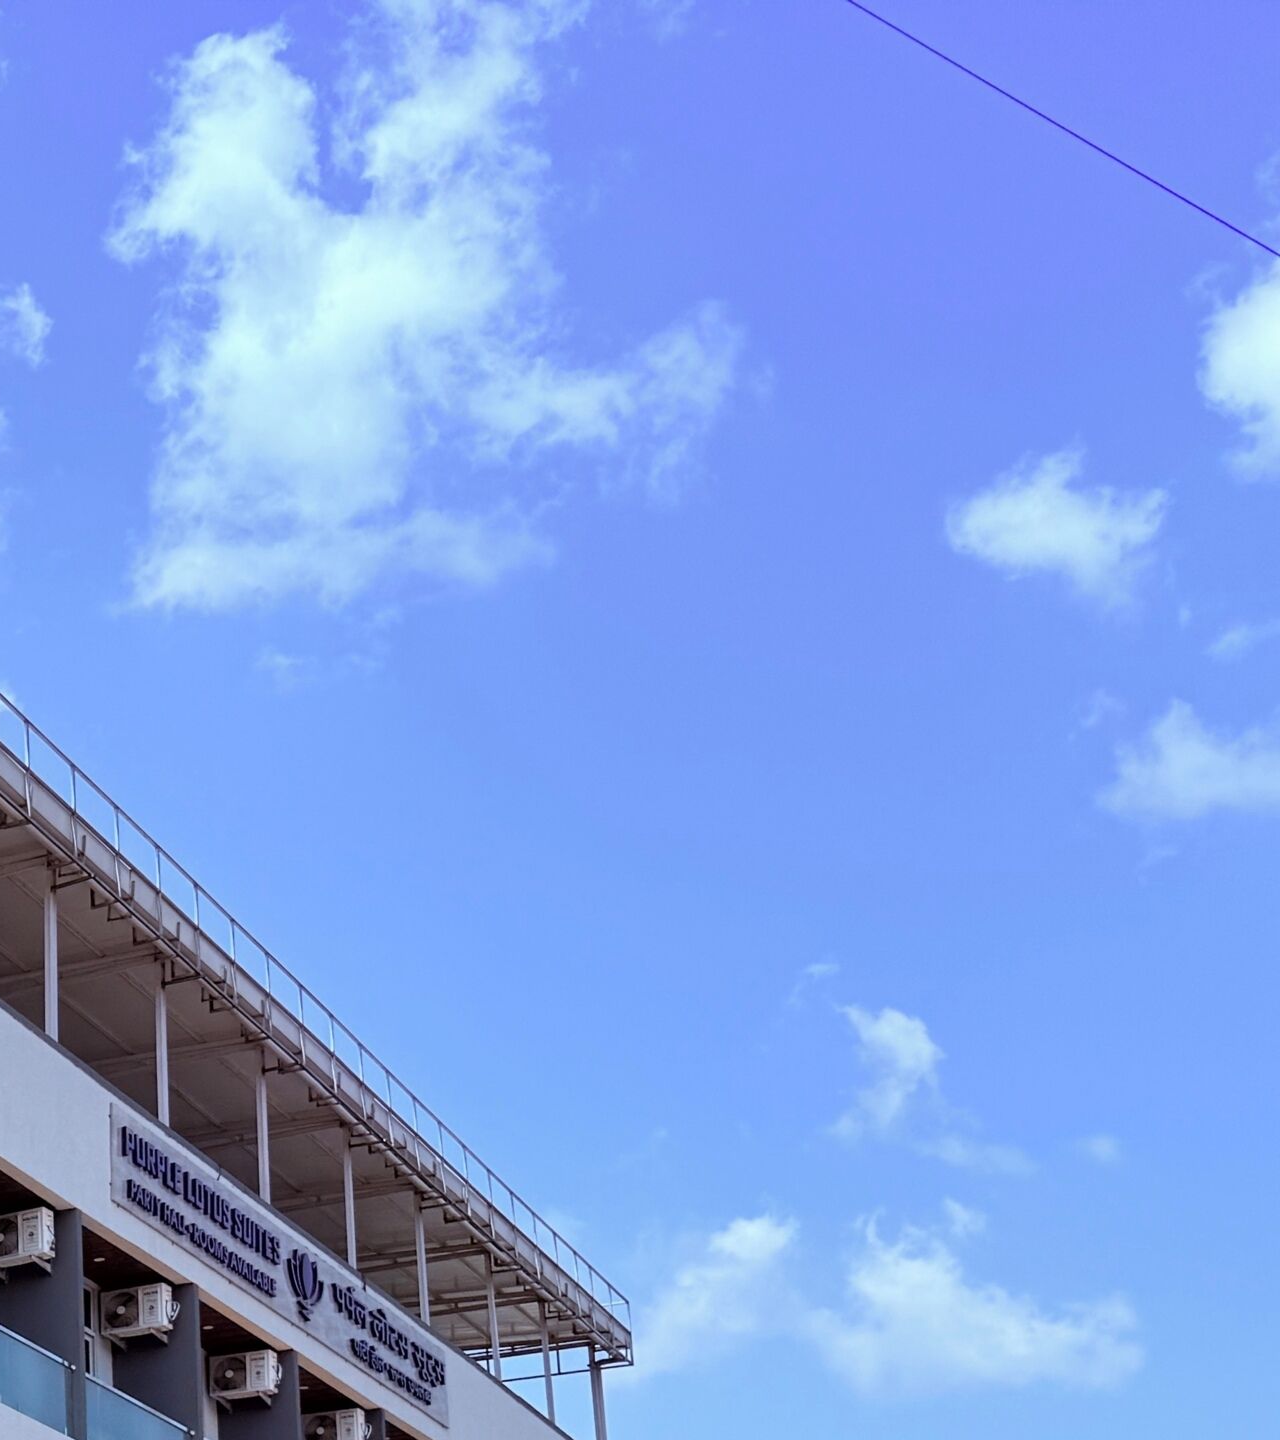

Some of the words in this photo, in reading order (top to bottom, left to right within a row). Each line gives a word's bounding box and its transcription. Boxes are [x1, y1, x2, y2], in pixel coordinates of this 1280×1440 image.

[121, 1126, 182, 1195] PURPLE
[183, 1171, 231, 1230] LOTUS
[230, 1207, 281, 1265] SUITES
